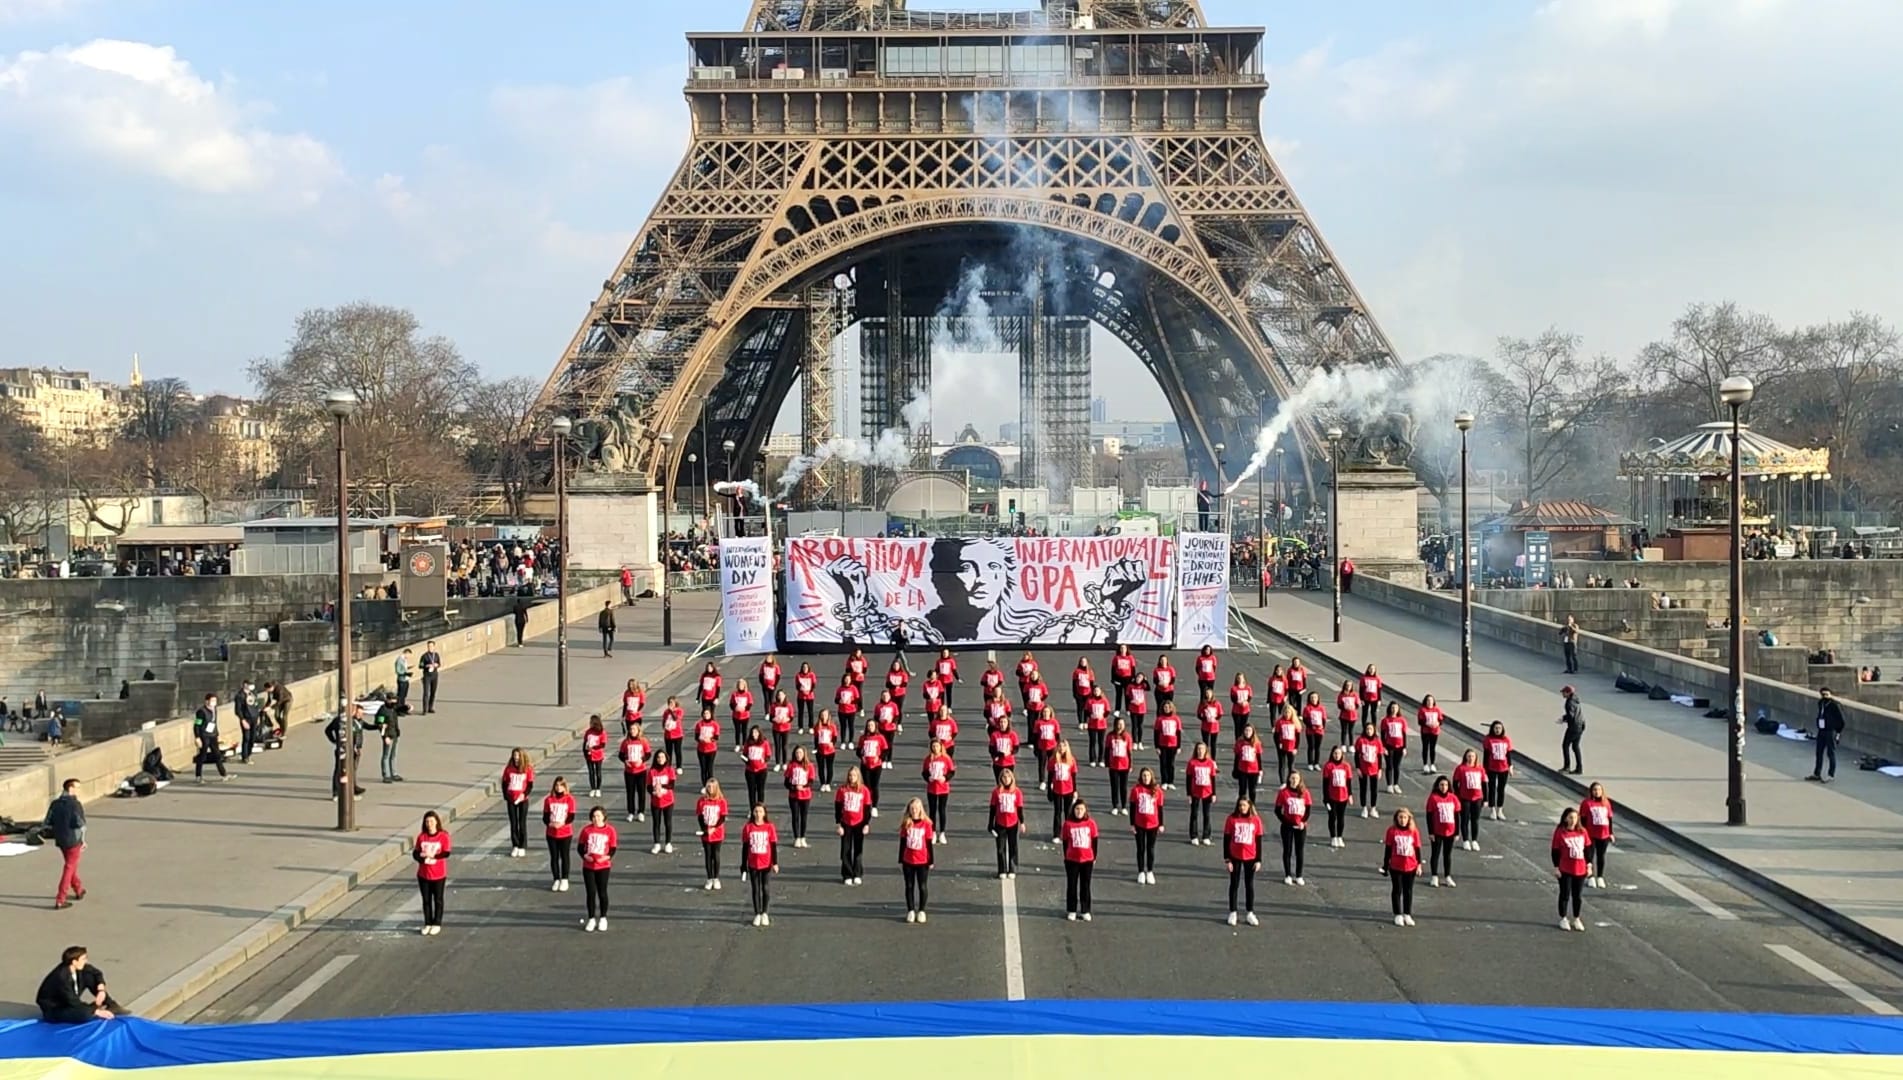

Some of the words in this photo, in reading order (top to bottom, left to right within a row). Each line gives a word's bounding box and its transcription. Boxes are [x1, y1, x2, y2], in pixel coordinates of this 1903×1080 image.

[788, 538, 927, 590] ABOLITION
[1015, 537, 1173, 579] INTERNATIONALE
[1191, 560, 1224, 571] DROITS
[732, 570, 756, 585] DAY
[1020, 564, 1081, 611] GPA
[885, 591, 901, 608] DE
[908, 589, 926, 611] LA
